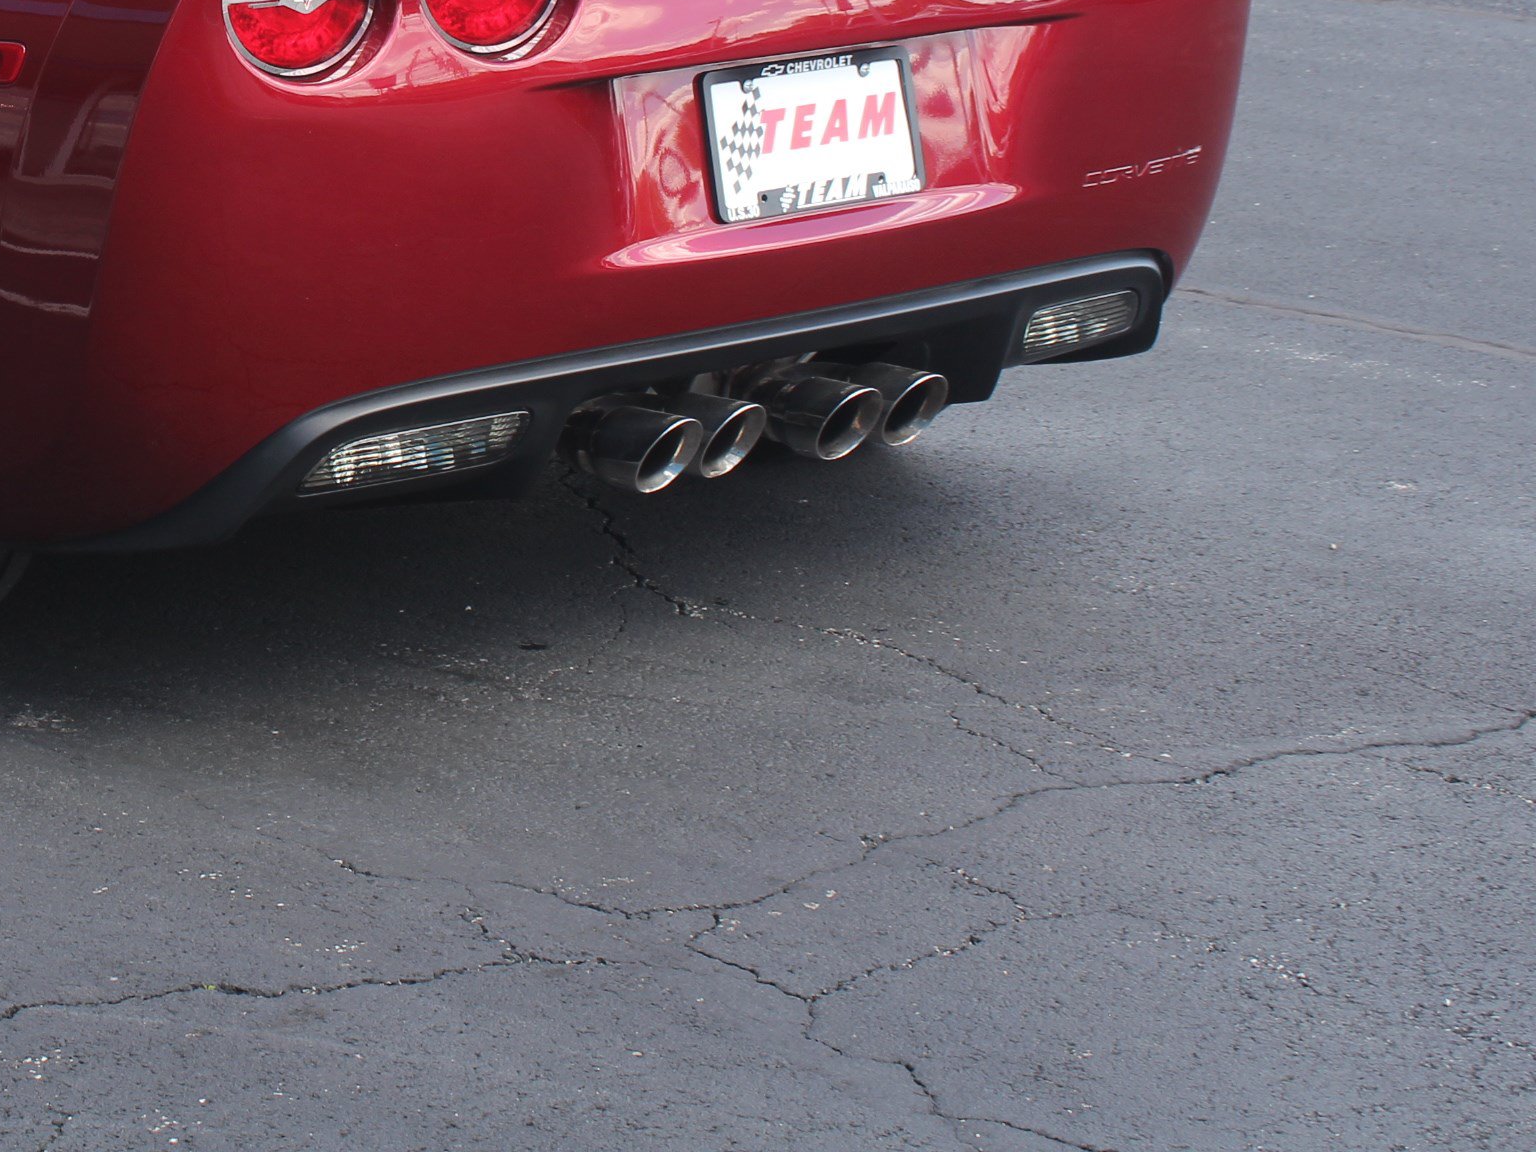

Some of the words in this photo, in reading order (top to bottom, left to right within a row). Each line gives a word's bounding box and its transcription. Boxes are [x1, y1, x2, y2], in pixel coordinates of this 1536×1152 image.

[786, 54, 853, 75] CHEVROLET
[760, 91, 896, 154] TEAM
[797, 172, 867, 205] TEAM
